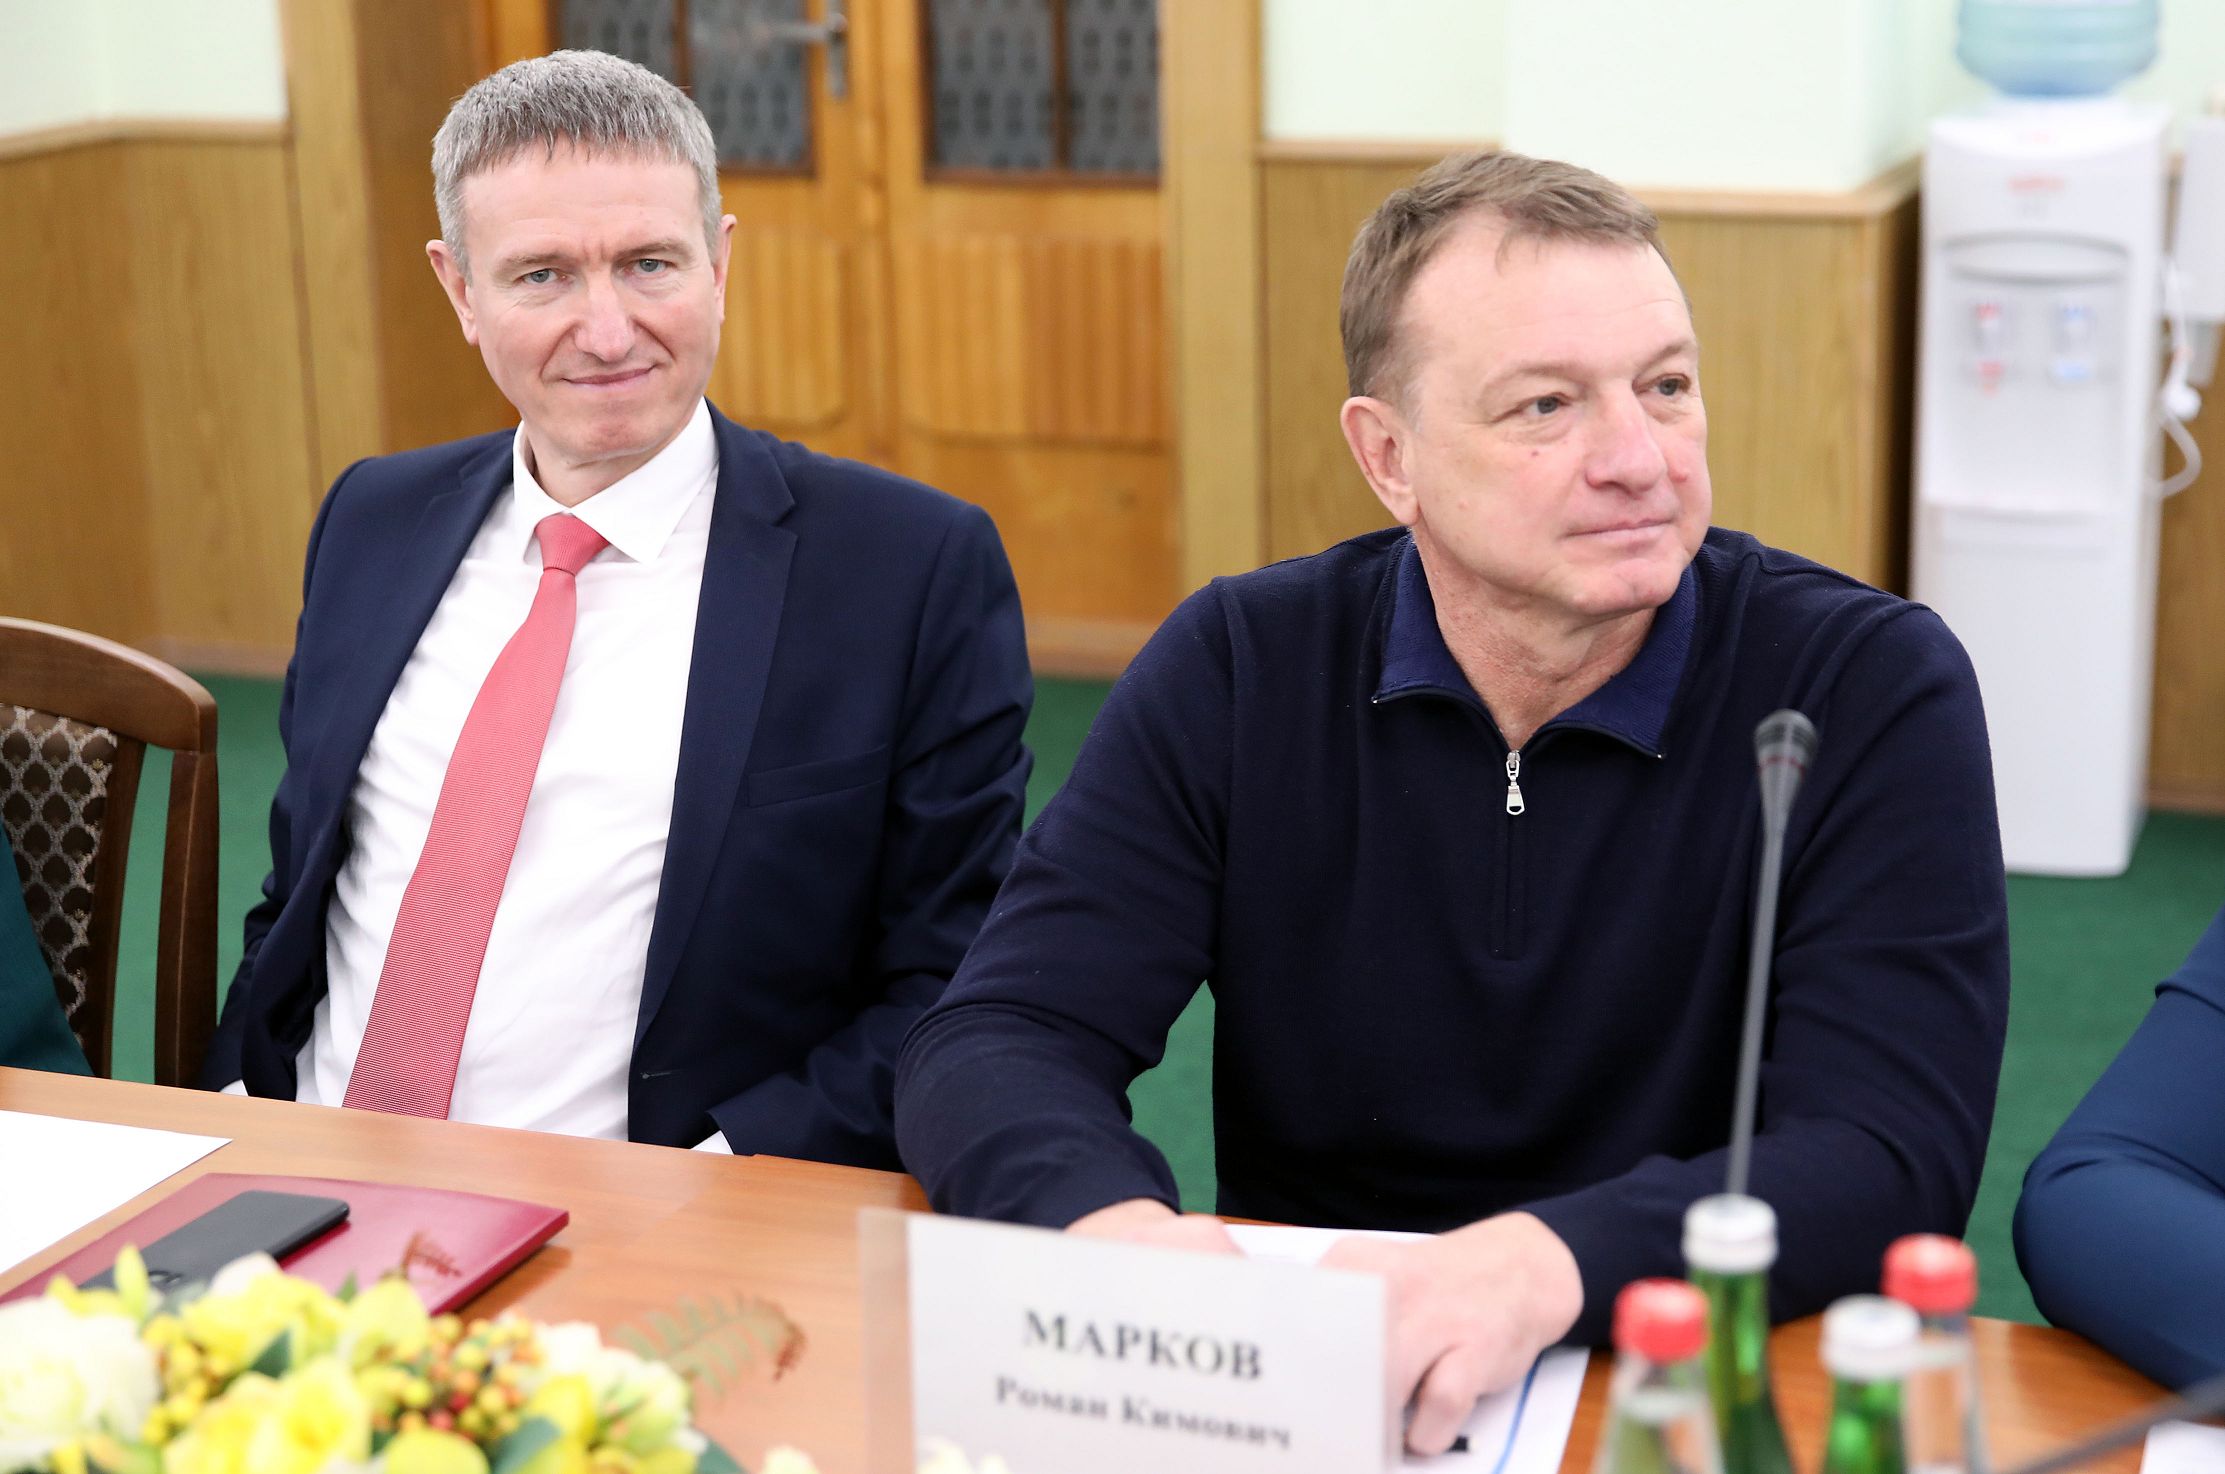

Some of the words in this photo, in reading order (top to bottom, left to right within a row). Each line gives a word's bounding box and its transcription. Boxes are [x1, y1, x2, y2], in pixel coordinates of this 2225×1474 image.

[1023, 1307, 1262, 1381] МАРКОВ
[995, 1375, 1109, 1420] Роман
[1121, 1394, 1292, 1450] Кимович
